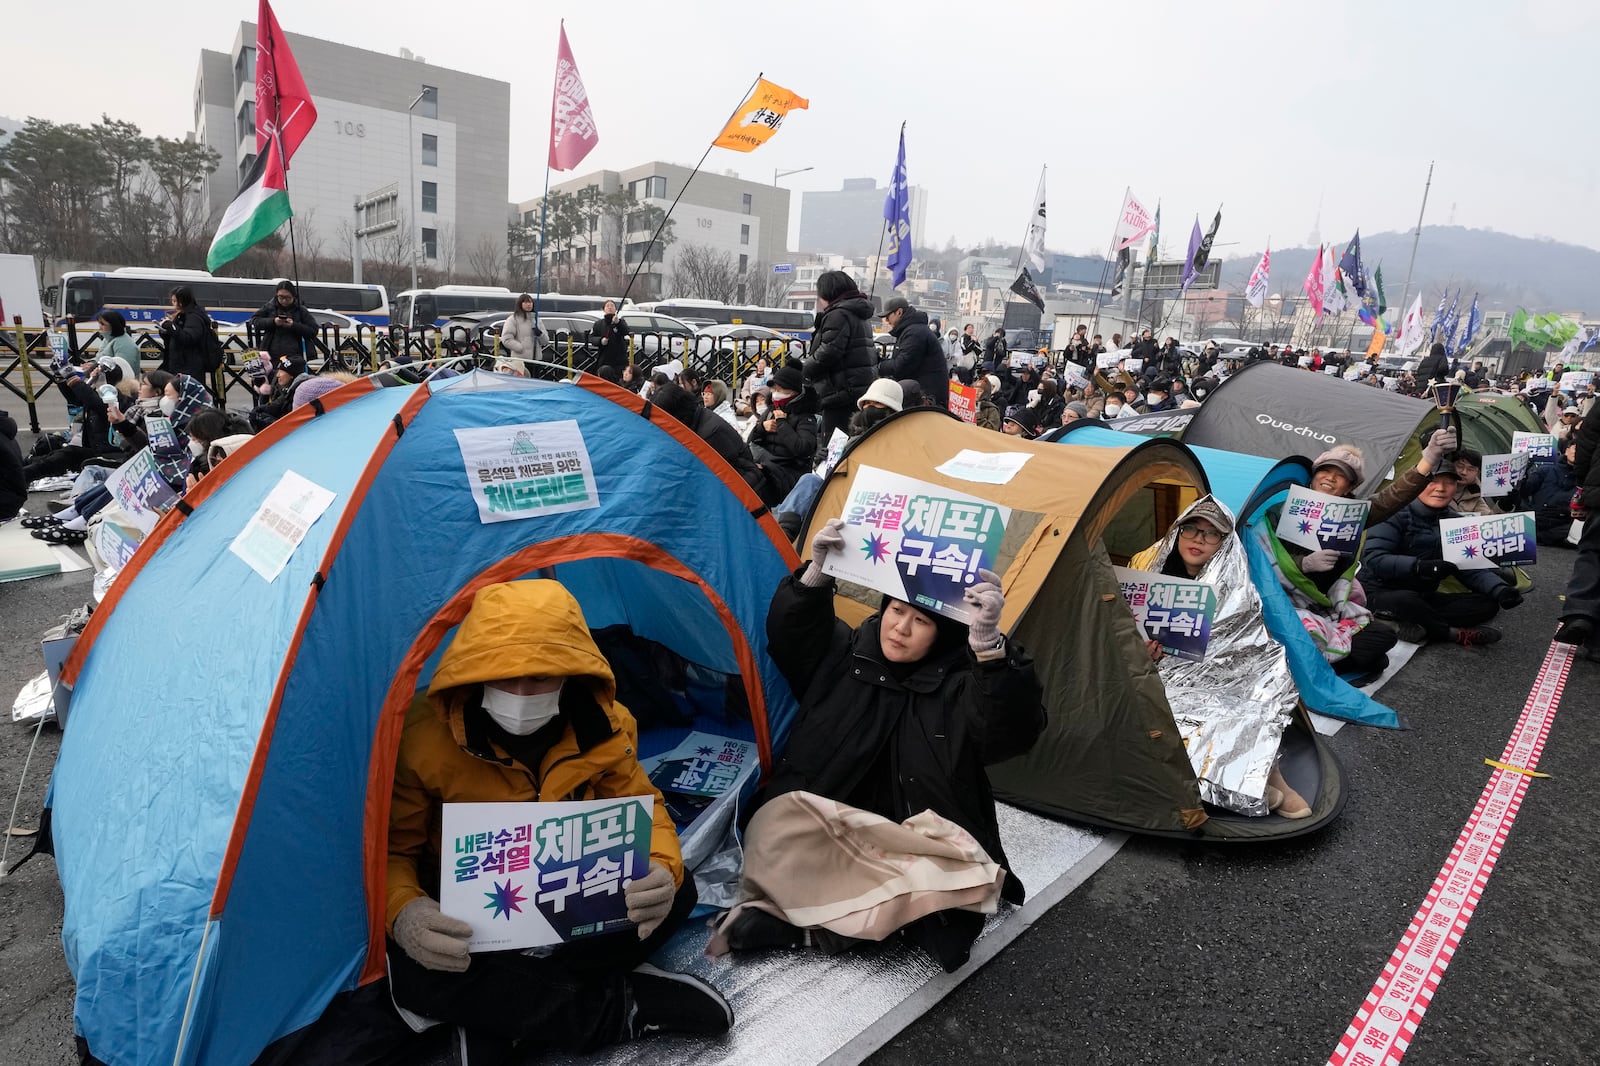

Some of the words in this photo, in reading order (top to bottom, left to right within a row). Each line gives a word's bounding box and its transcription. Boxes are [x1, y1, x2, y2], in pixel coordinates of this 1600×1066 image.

[333, 120, 366, 138] 108
[696, 217, 712, 228] 109
[1255, 413, 1337, 444] Quechua
[125, 450, 151, 491] 체포!
[477, 466, 517, 483] 윤석열
[518, 461, 555, 478] 체포를
[556, 458, 582, 473] 위한
[135, 470, 161, 507] 구속!
[853, 490, 908, 510] 내란수괴
[1288, 505, 1322, 519] 윤석열
[1291, 497, 1325, 509] 내란수괴
[1322, 502, 1367, 523] 체포!
[846, 505, 902, 531] 윤석열
[904, 498, 994, 544] 체포!
[1481, 515, 1525, 540] 해체
[1318, 522, 1360, 542] 구속!
[1445, 524, 1479, 538] 내란동조
[1447, 532, 1480, 545] 국민의힘
[1482, 534, 1526, 557] 하라
[897, 538, 983, 584] 구속!
[1119, 582, 1149, 593] 란수괴
[1148, 583, 1209, 610] 체포!
[1144, 610, 1205, 637] 구속!
[454, 823, 533, 855] 내란수괴
[537, 802, 637, 865] 체포!
[453, 844, 531, 883] 윤석열
[1463, 843, 1485, 866] DANGER
[537, 849, 635, 914] 구속!
[1447, 867, 1474, 896] 안전제일
[1430, 912, 1451, 929] 위험
[1414, 929, 1442, 959] DANGER
[1389, 962, 1425, 1003] 안전제일
[1363, 1026, 1391, 1051] 위험
